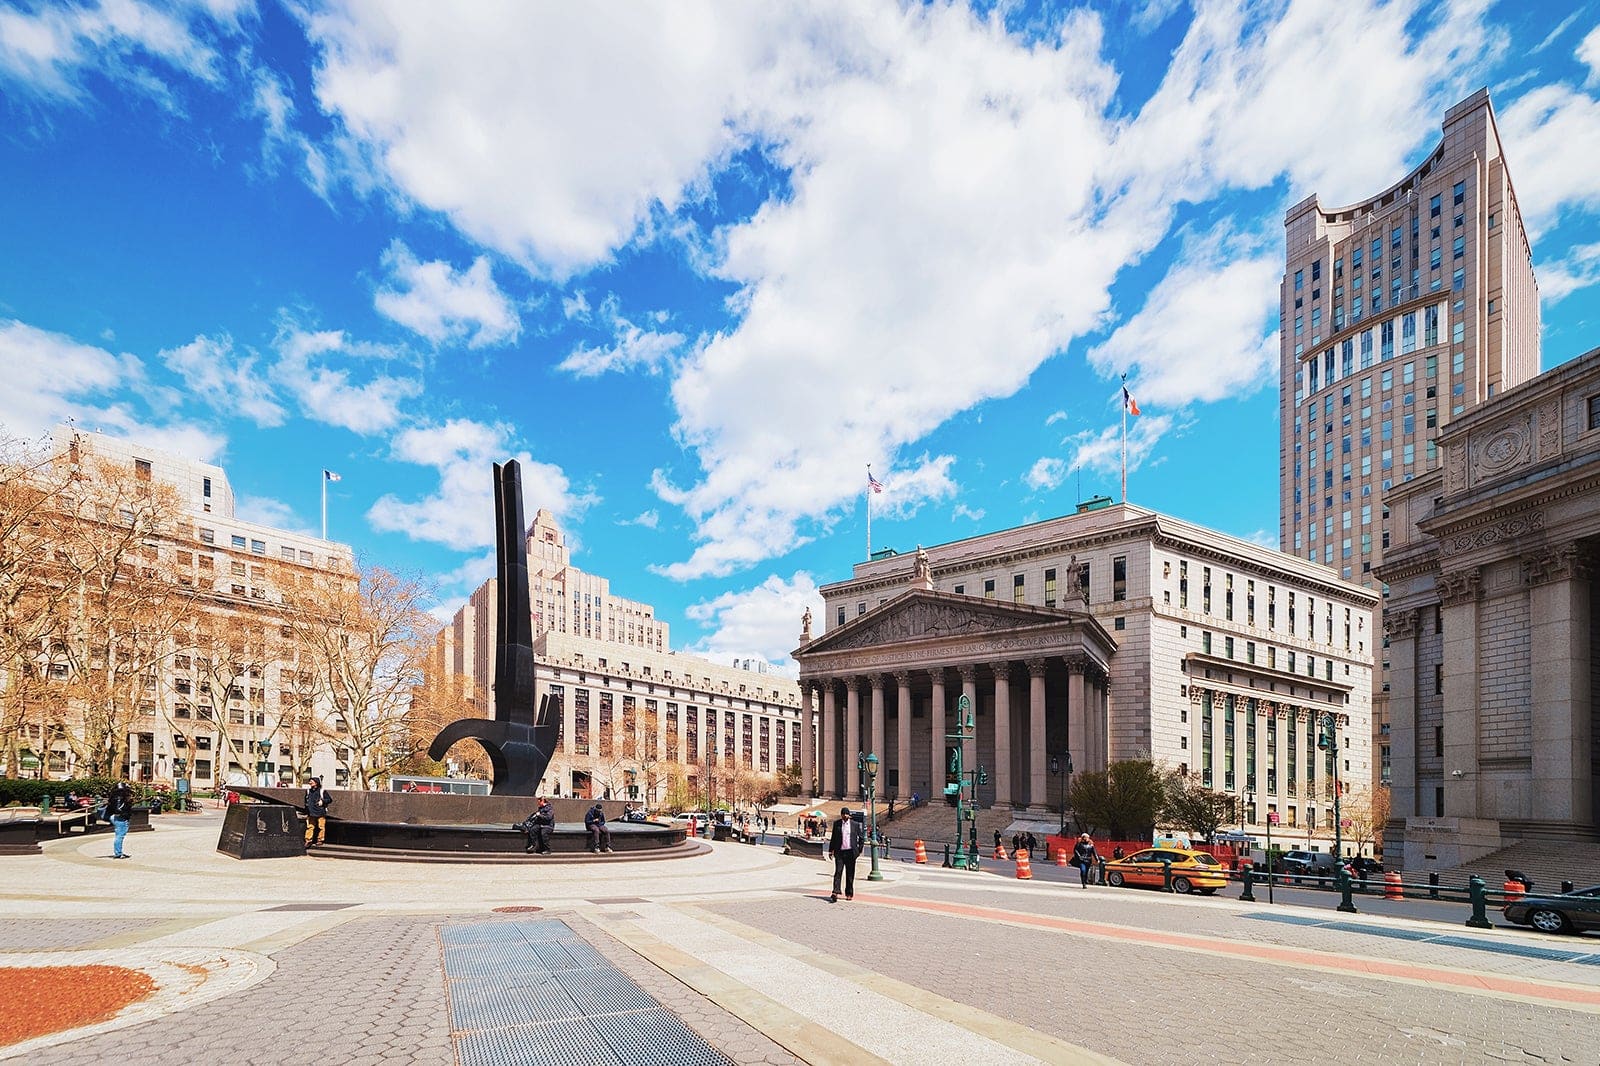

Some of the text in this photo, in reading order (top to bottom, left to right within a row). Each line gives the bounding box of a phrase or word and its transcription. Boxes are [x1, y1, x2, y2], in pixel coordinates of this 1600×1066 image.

[927, 647, 953, 657] FIRMEST
[991, 640, 1014, 649] GOOD
[1017, 633, 1073, 647] GOVERNMENT
